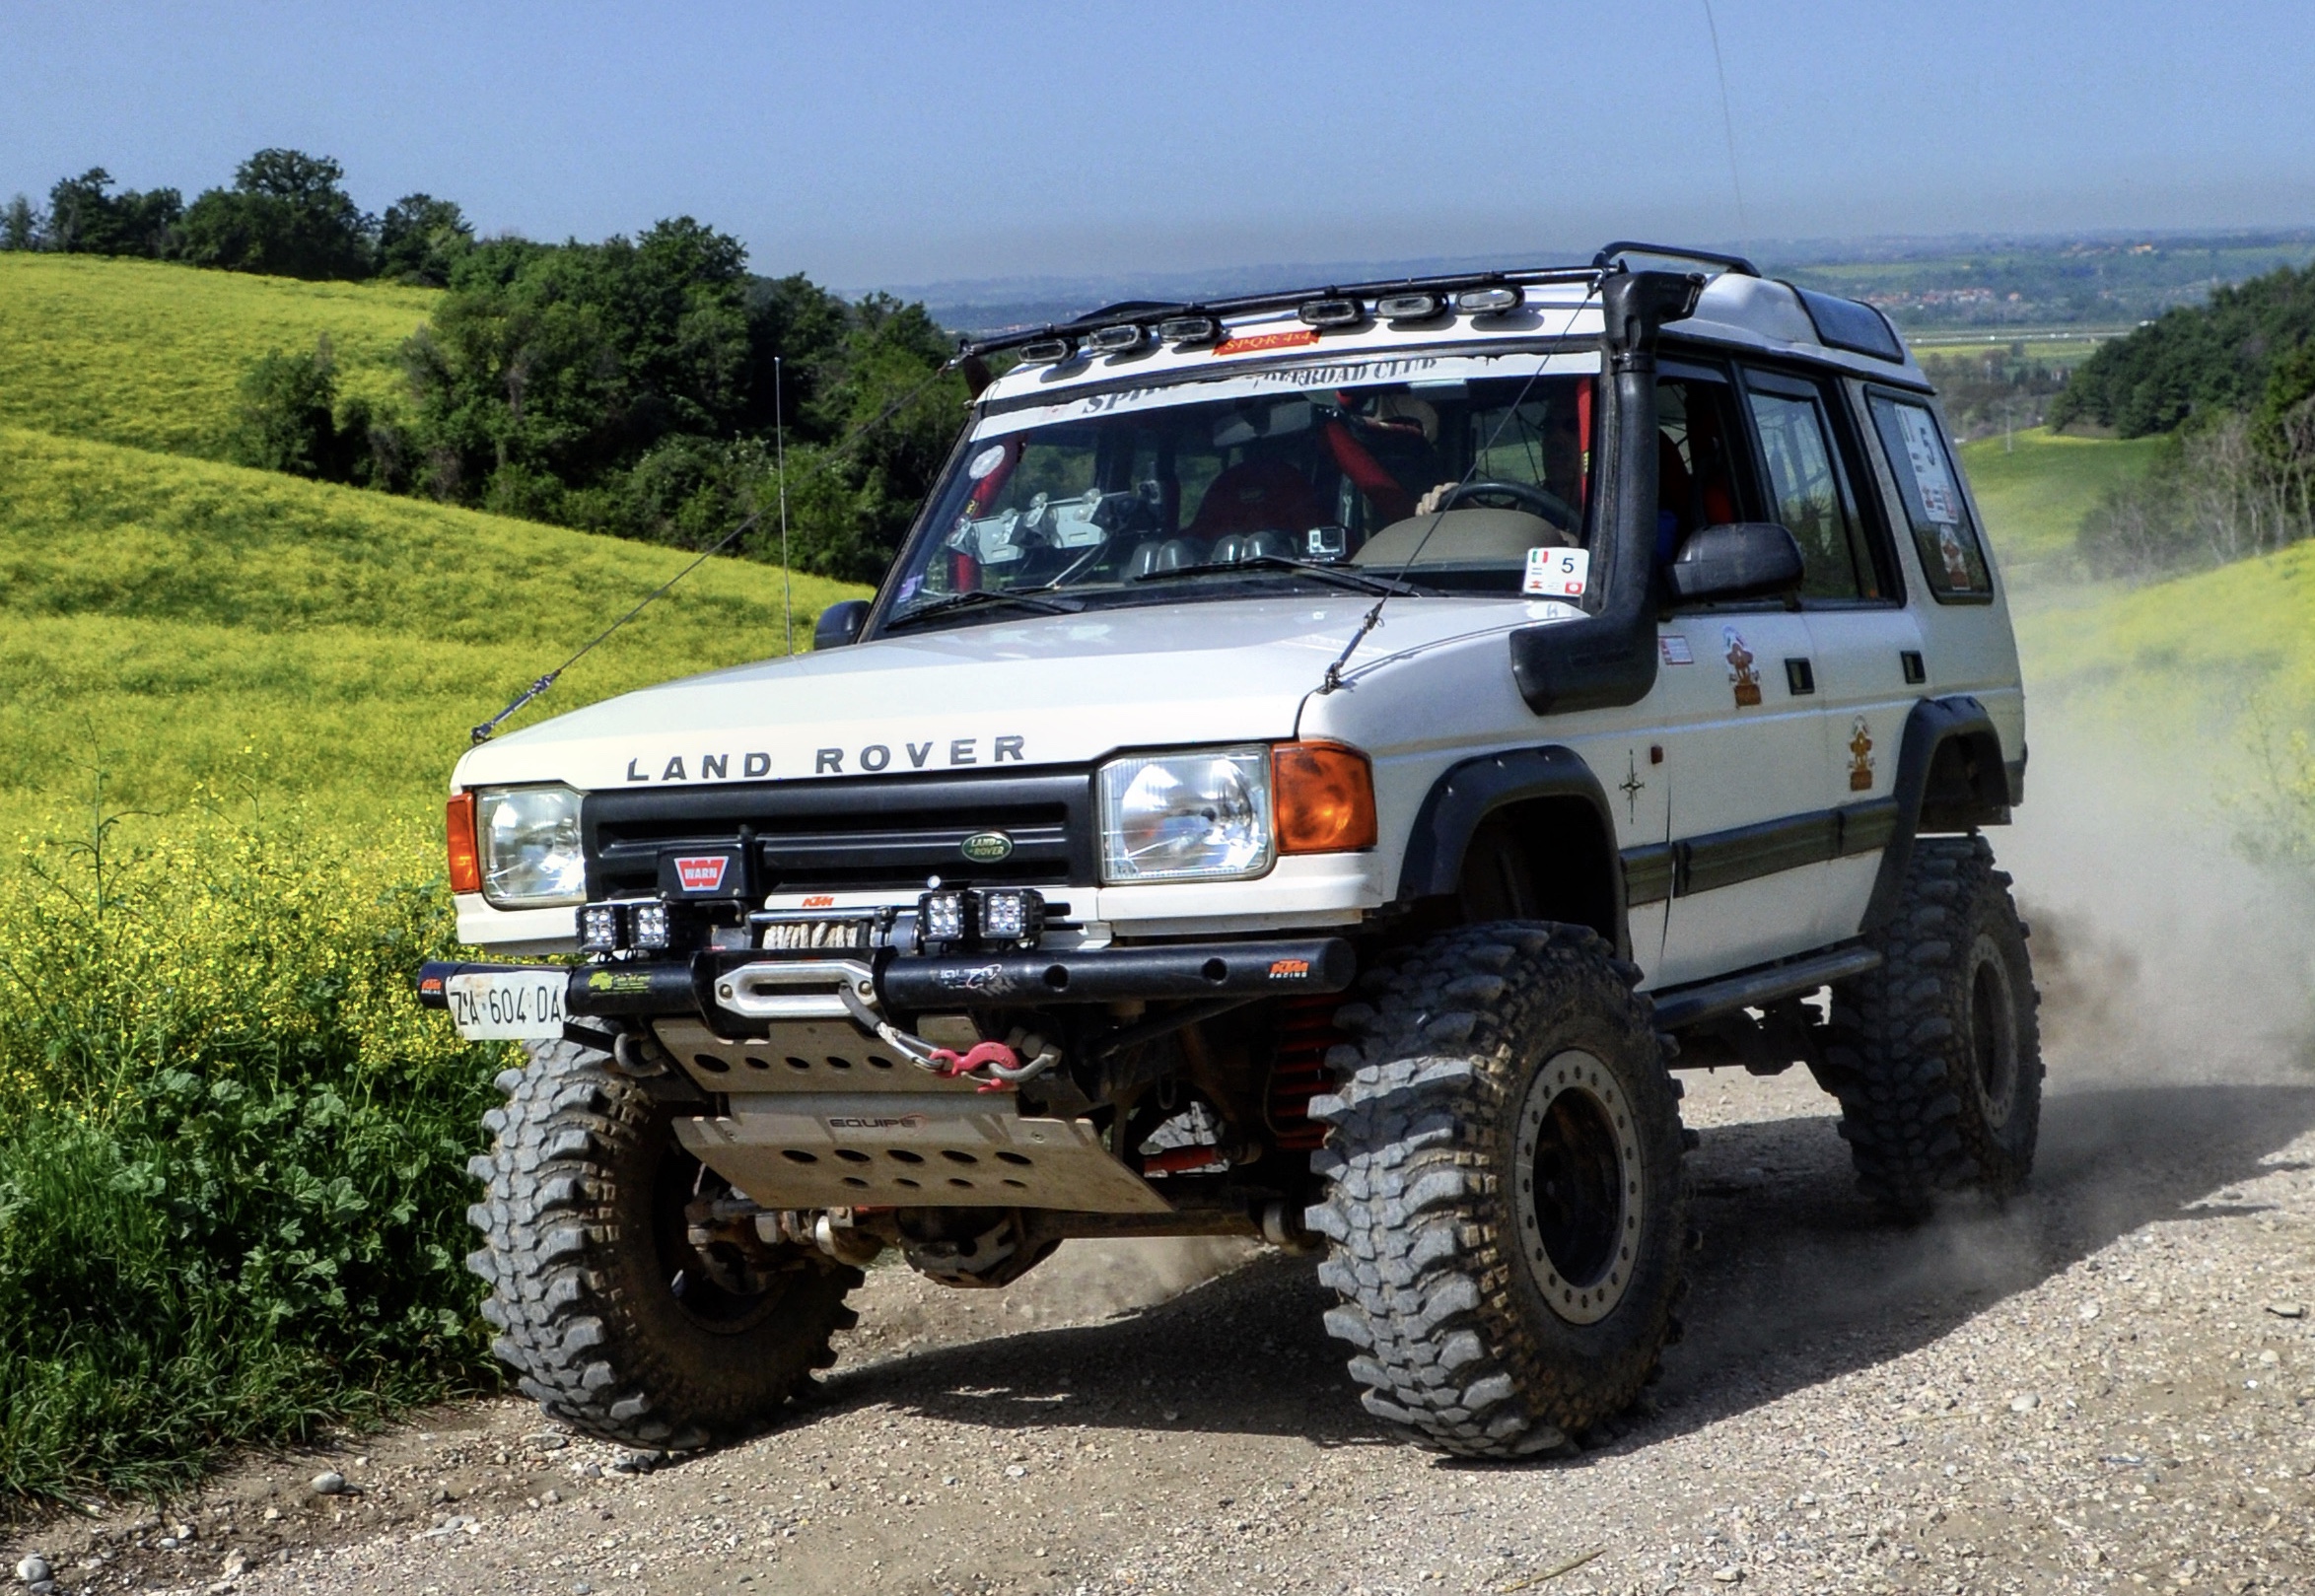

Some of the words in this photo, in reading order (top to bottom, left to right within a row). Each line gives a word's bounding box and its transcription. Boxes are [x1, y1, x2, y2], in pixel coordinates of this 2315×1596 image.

[1561, 557, 1575, 574] 5
[627, 752, 772, 782] LAND
[814, 735, 1025, 775] ROVER
[971, 838, 997, 847] LAND
[973, 847, 1005, 856] ROVER
[684, 867, 717, 879] WARN
[801, 896, 835, 908] KTM
[1270, 959, 1309, 973] KTM
[488, 987, 526, 1024] 604
[829, 1118, 917, 1128] EQUIPE
